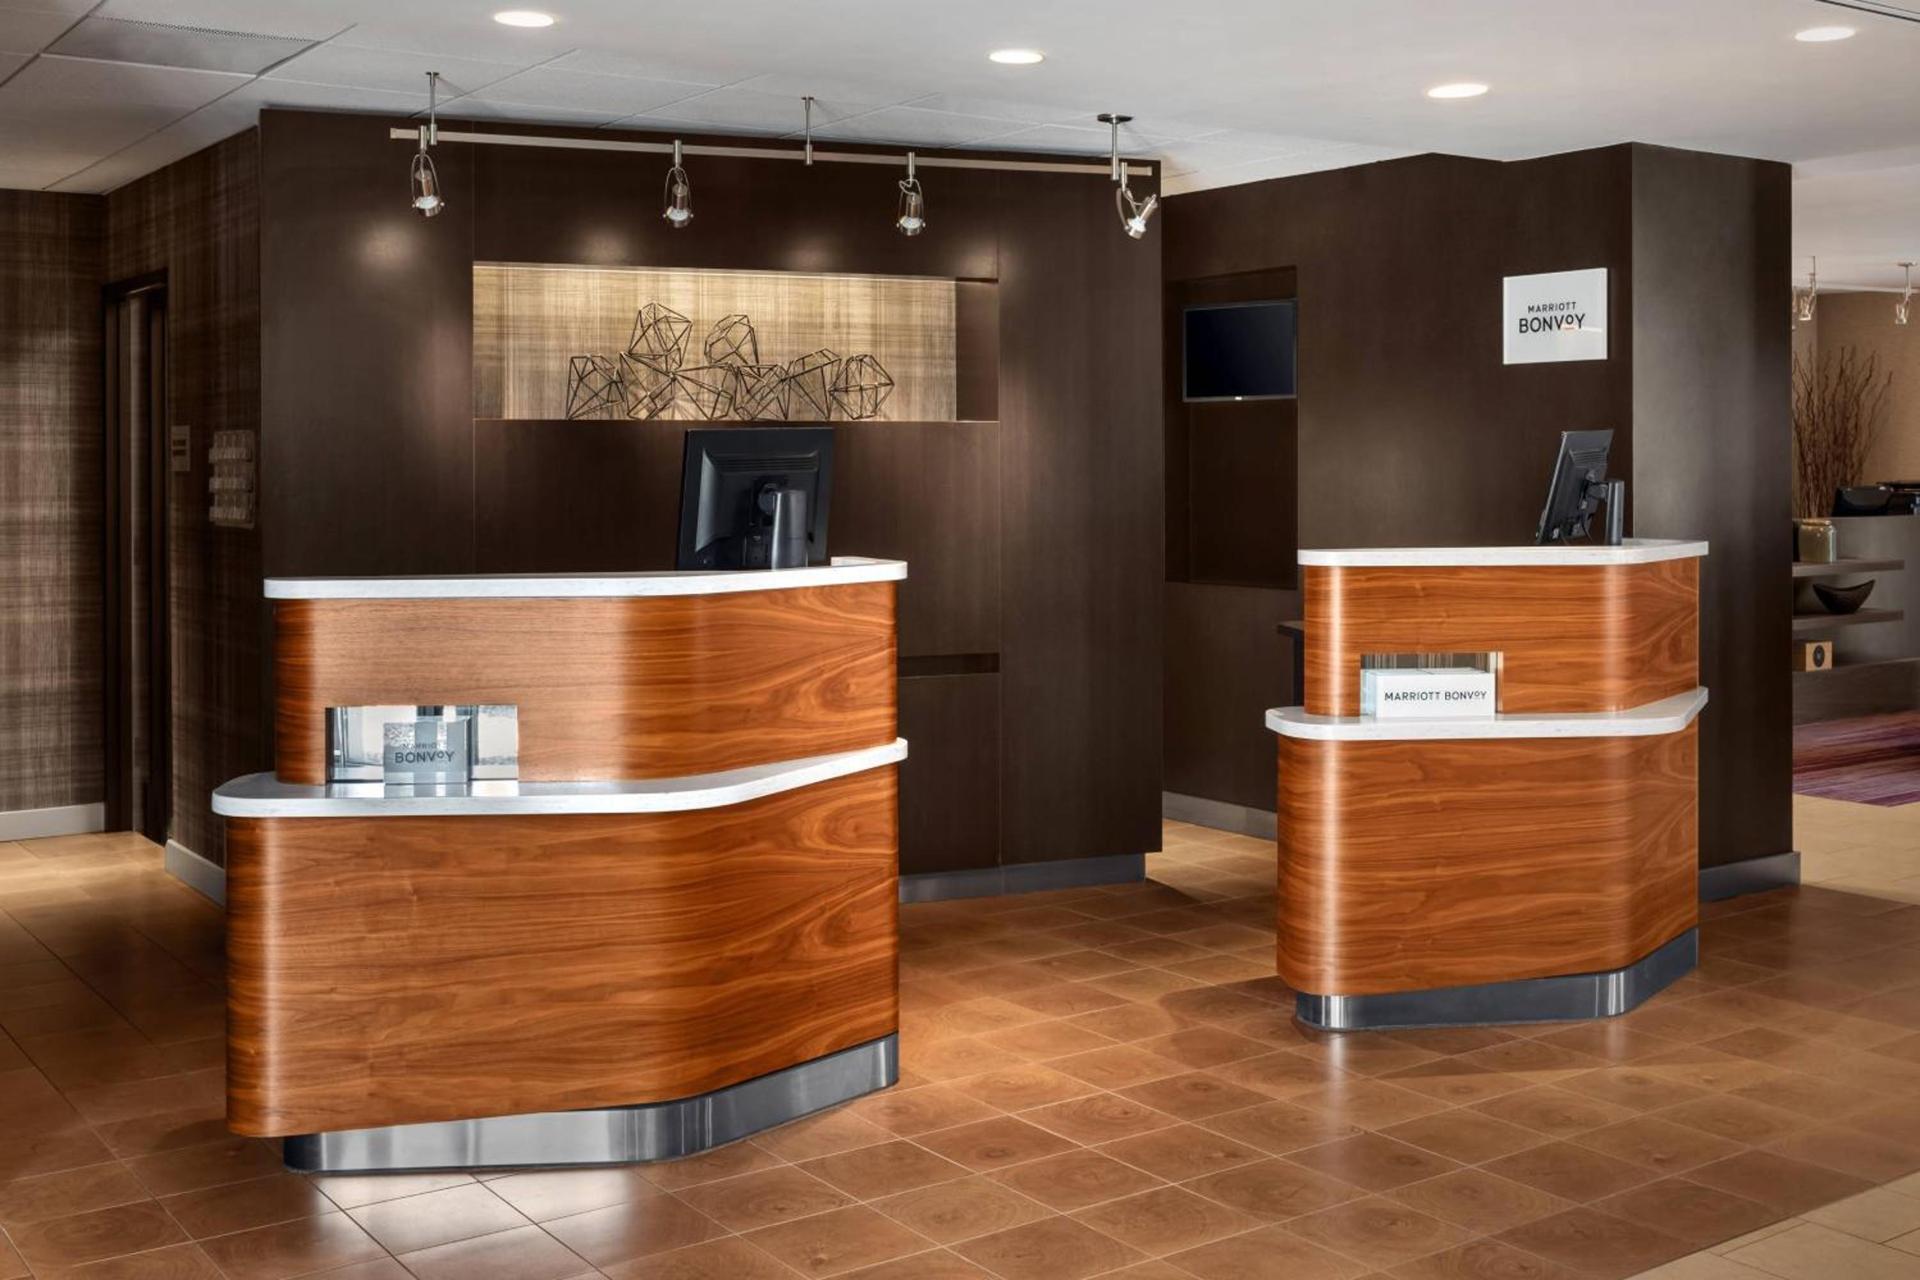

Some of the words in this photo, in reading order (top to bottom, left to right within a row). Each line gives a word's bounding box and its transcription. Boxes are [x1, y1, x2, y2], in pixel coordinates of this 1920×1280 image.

[1528, 301, 1577, 313] MARRIOTT
[1519, 314, 1586, 333] BONVOY
[1384, 691, 1440, 701] MARRIOTT
[1444, 691, 1487, 700] BONVOY
[395, 751, 455, 763] BONVOY
